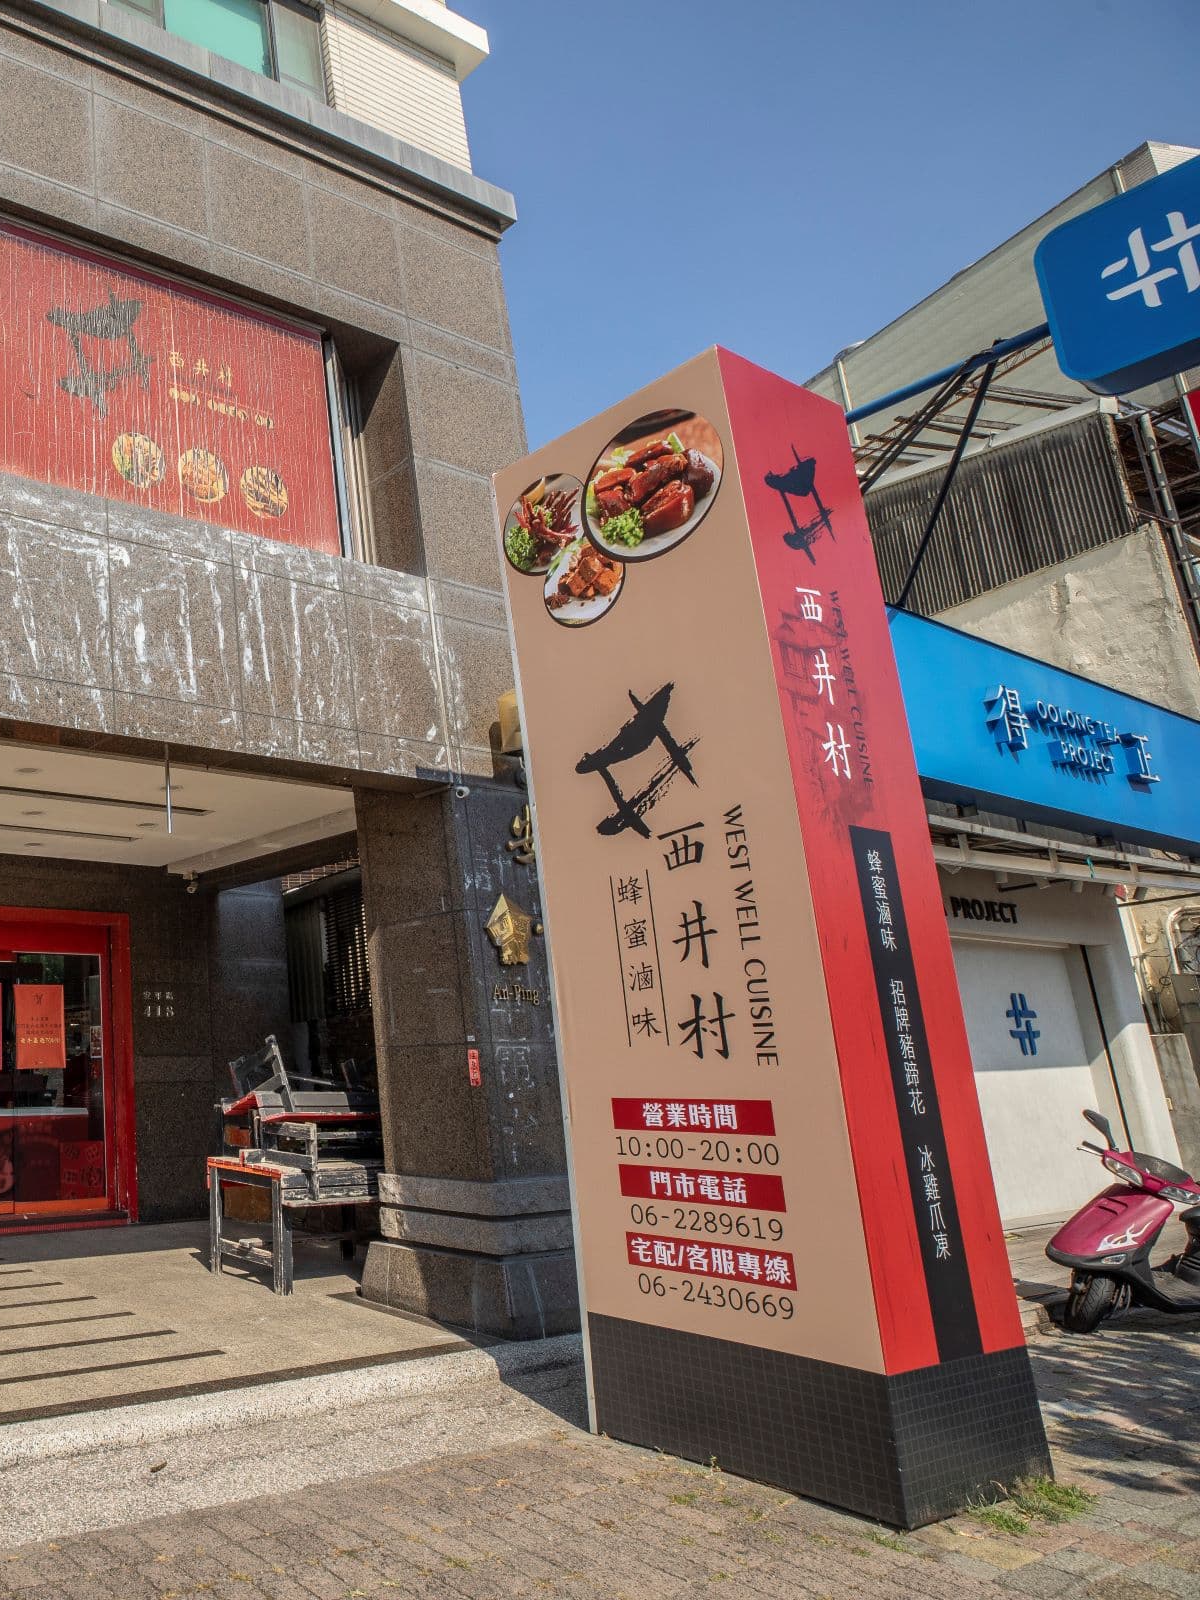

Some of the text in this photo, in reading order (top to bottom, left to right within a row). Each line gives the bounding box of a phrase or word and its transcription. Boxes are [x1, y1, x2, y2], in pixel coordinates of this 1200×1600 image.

[795, 586, 851, 779] 西井村
[829, 590, 873, 792] WEST WELL CUISINE
[988, 685, 1031, 749] 得
[1036, 700, 1122, 744] OOLONG TEA
[1060, 741, 1115, 773] PROJECT
[949, 896, 1018, 923] PROJECT
[617, 876, 662, 1038] 蜂蜜滷味
[657, 821, 736, 1060] 西井村
[723, 804, 779, 1067] WEST WELL CUISINE
[493, 984, 540, 1006] An-Ping
[867, 849, 897, 952] 蜂蜜滷味
[889, 979, 926, 1116] 招牌豬蹄花
[642, 1103, 738, 1130] 營業時間
[615, 1135, 780, 1166] 10:00-20:00
[649, 1170, 748, 1204] 門市電話
[630, 1203, 783, 1242] 06-2289619
[630, 1237, 792, 1285] 宅配/客服專線
[638, 1273, 794, 1321] 06-2430669
